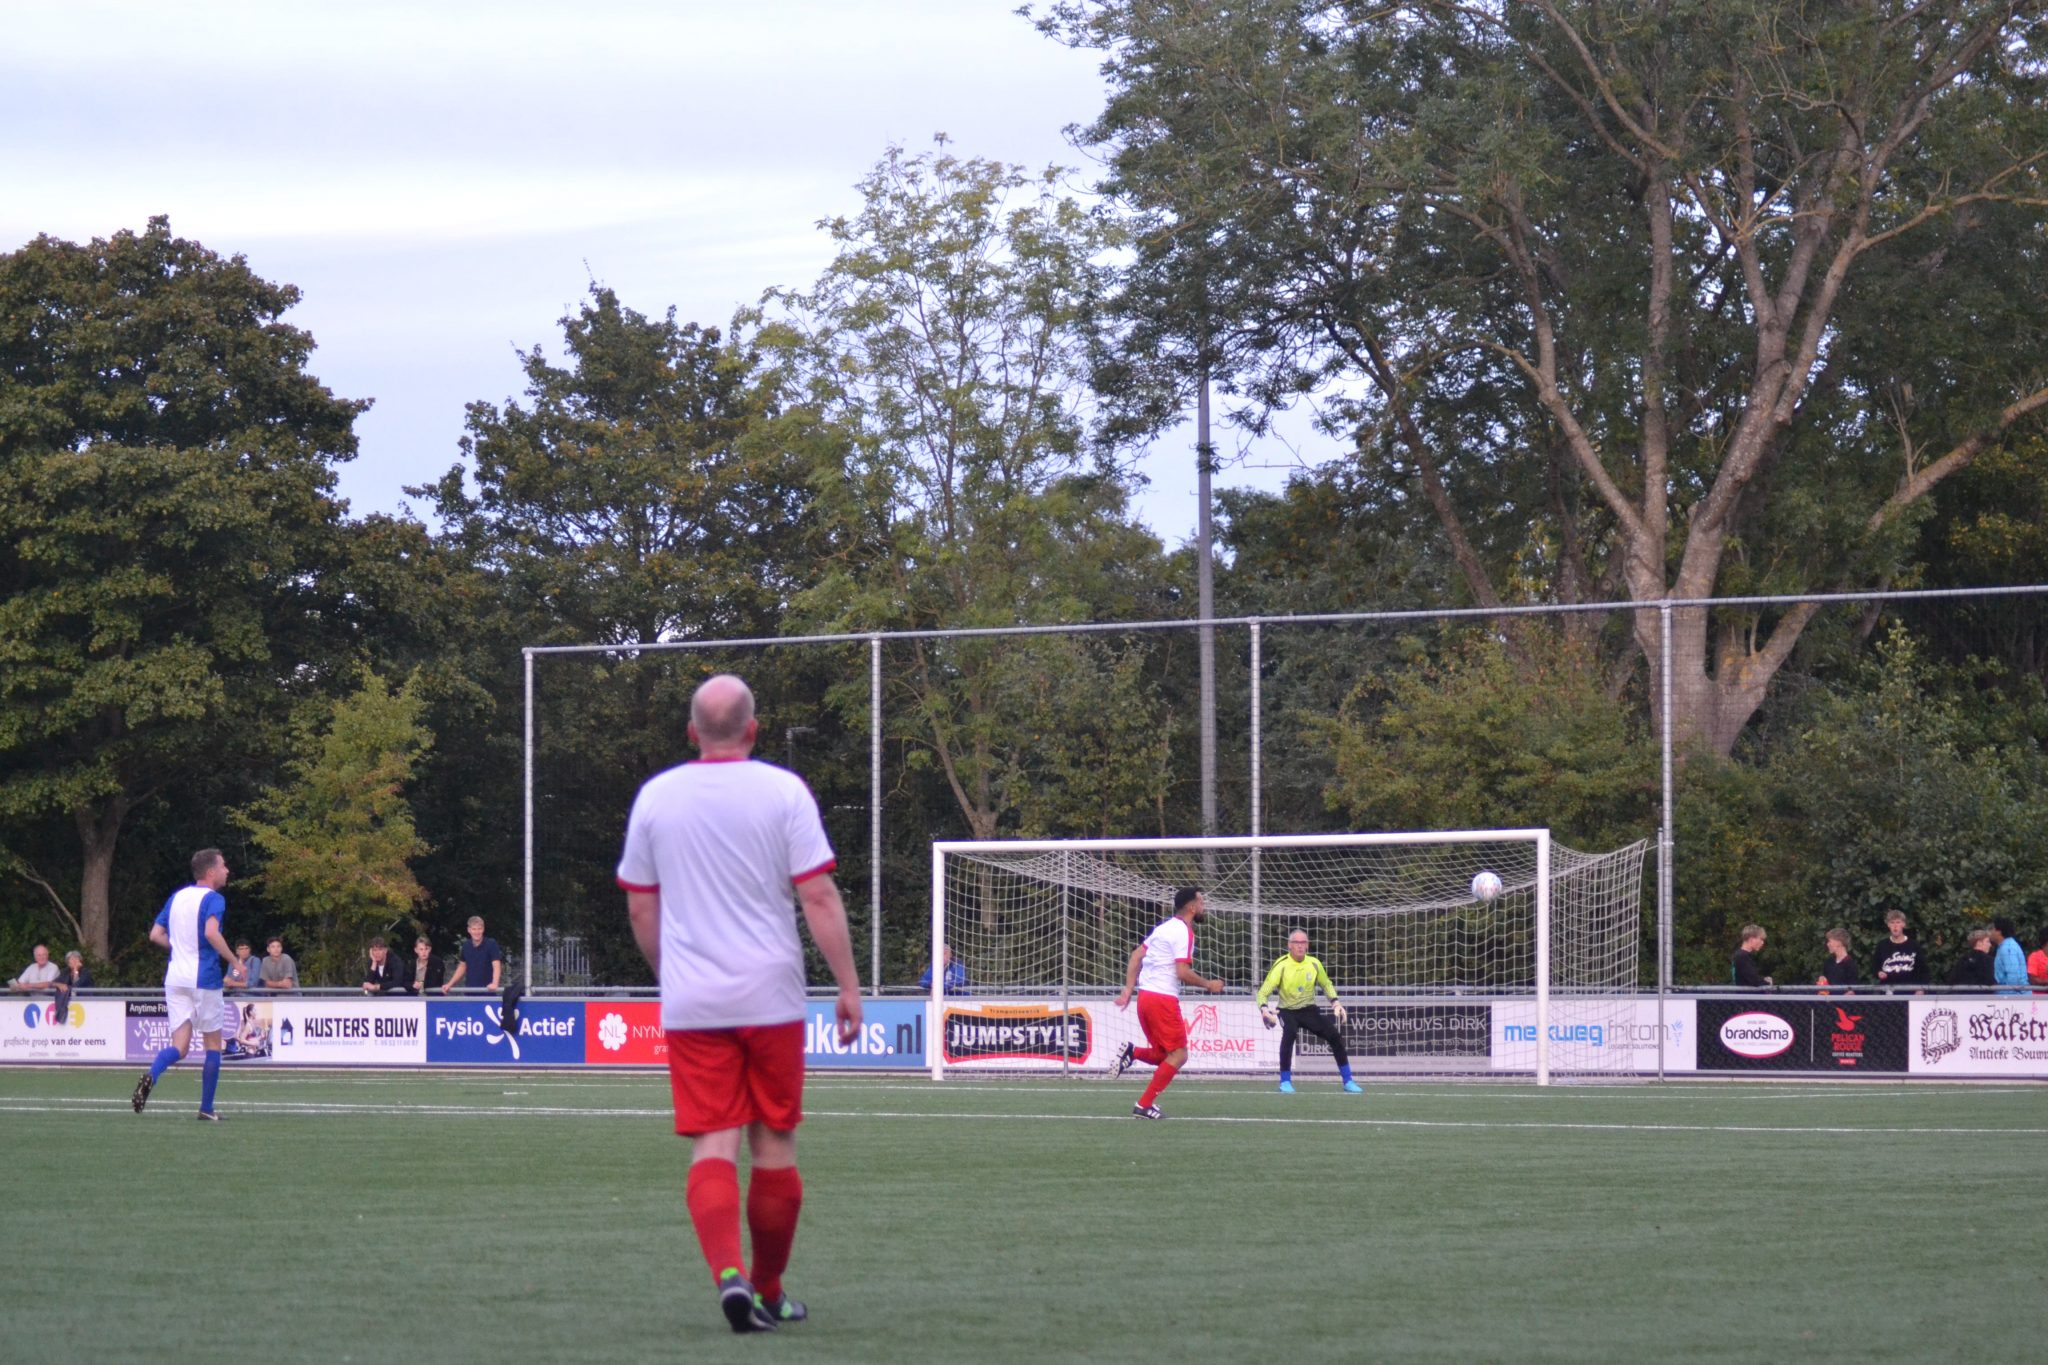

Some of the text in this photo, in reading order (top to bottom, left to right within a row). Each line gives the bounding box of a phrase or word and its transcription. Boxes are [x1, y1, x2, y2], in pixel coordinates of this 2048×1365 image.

[129, 1004, 157, 1014] Anytime
[305, 1018, 418, 1038] KUSTERS BOUW
[436, 1017, 576, 1039] Fysio Actief
[1351, 1017, 1487, 1031] WOONHUYS DIRK
[1608, 1020, 1669, 1041] fritom
[604, 1025, 620, 1038] NL
[951, 1024, 1080, 1047] JUMPSTYLE
[1725, 1026, 1789, 1040] brandsma
[4, 1037, 30, 1047] grafische
[32, 1039, 49, 1047] groep
[68, 1037, 82, 1046] der
[84, 1038, 106, 1046] eems
[1300, 1043, 1332, 1054] DIRK
